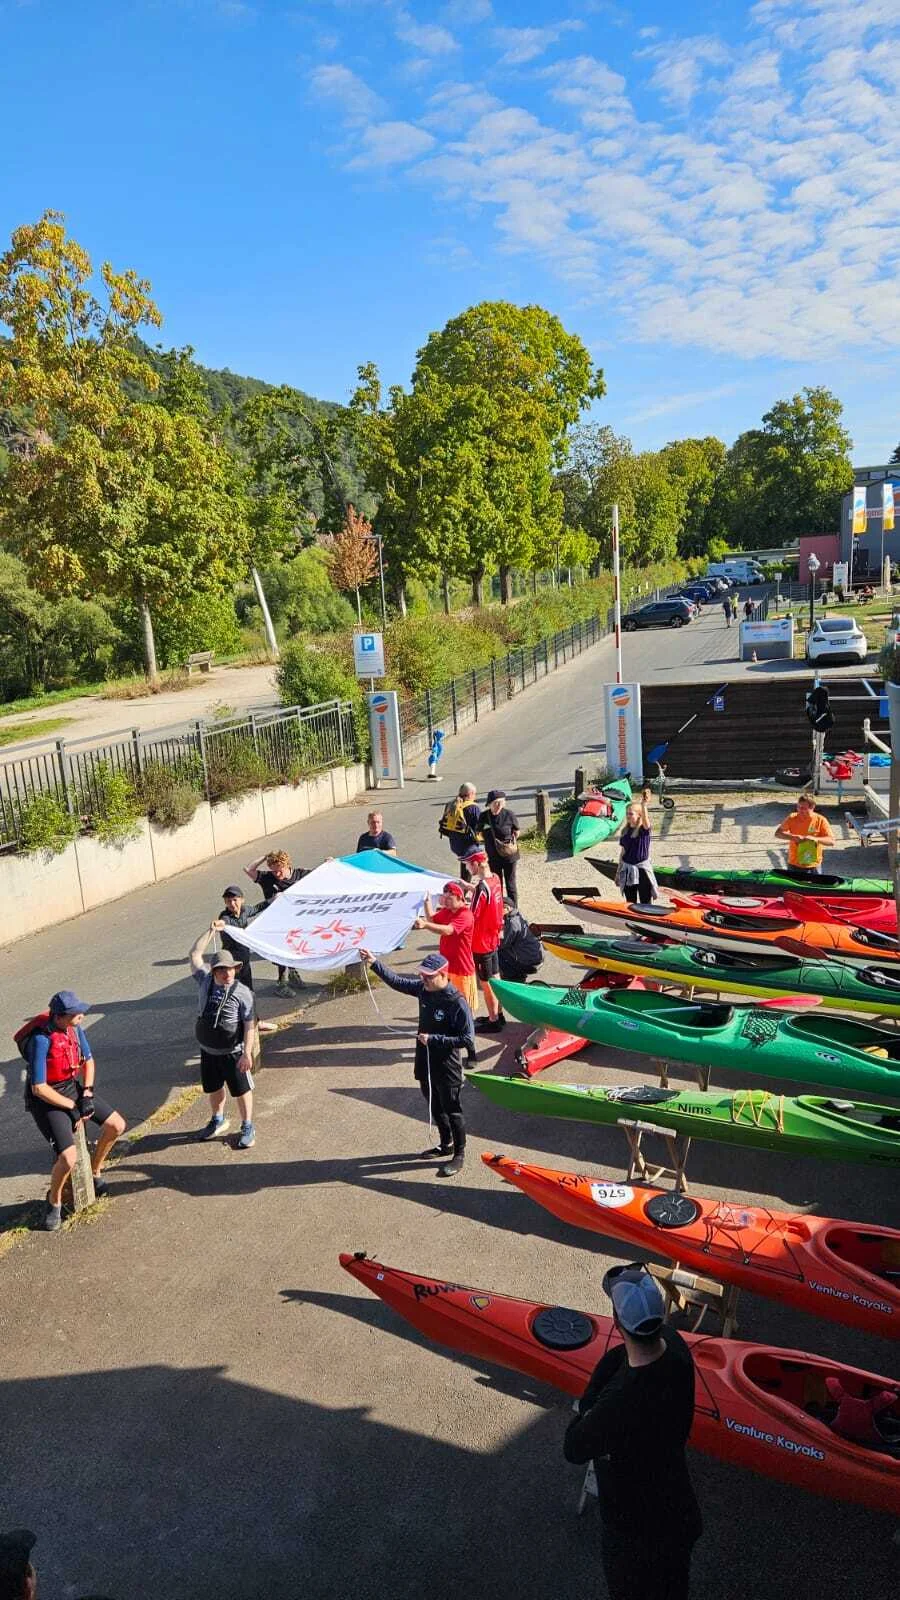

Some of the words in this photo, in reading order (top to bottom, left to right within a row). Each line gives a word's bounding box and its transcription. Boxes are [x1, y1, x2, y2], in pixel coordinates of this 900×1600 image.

[294, 891, 408, 906] Olympics
[295, 902, 393, 916] Special
[678, 1103, 712, 1115] Nims
[598, 1188, 626, 1199] 576
[808, 1280, 850, 1300] Venture
[852, 1294, 894, 1314] Kayaks
[725, 1417, 774, 1443] Venture
[776, 1434, 825, 1461] Kayaks
